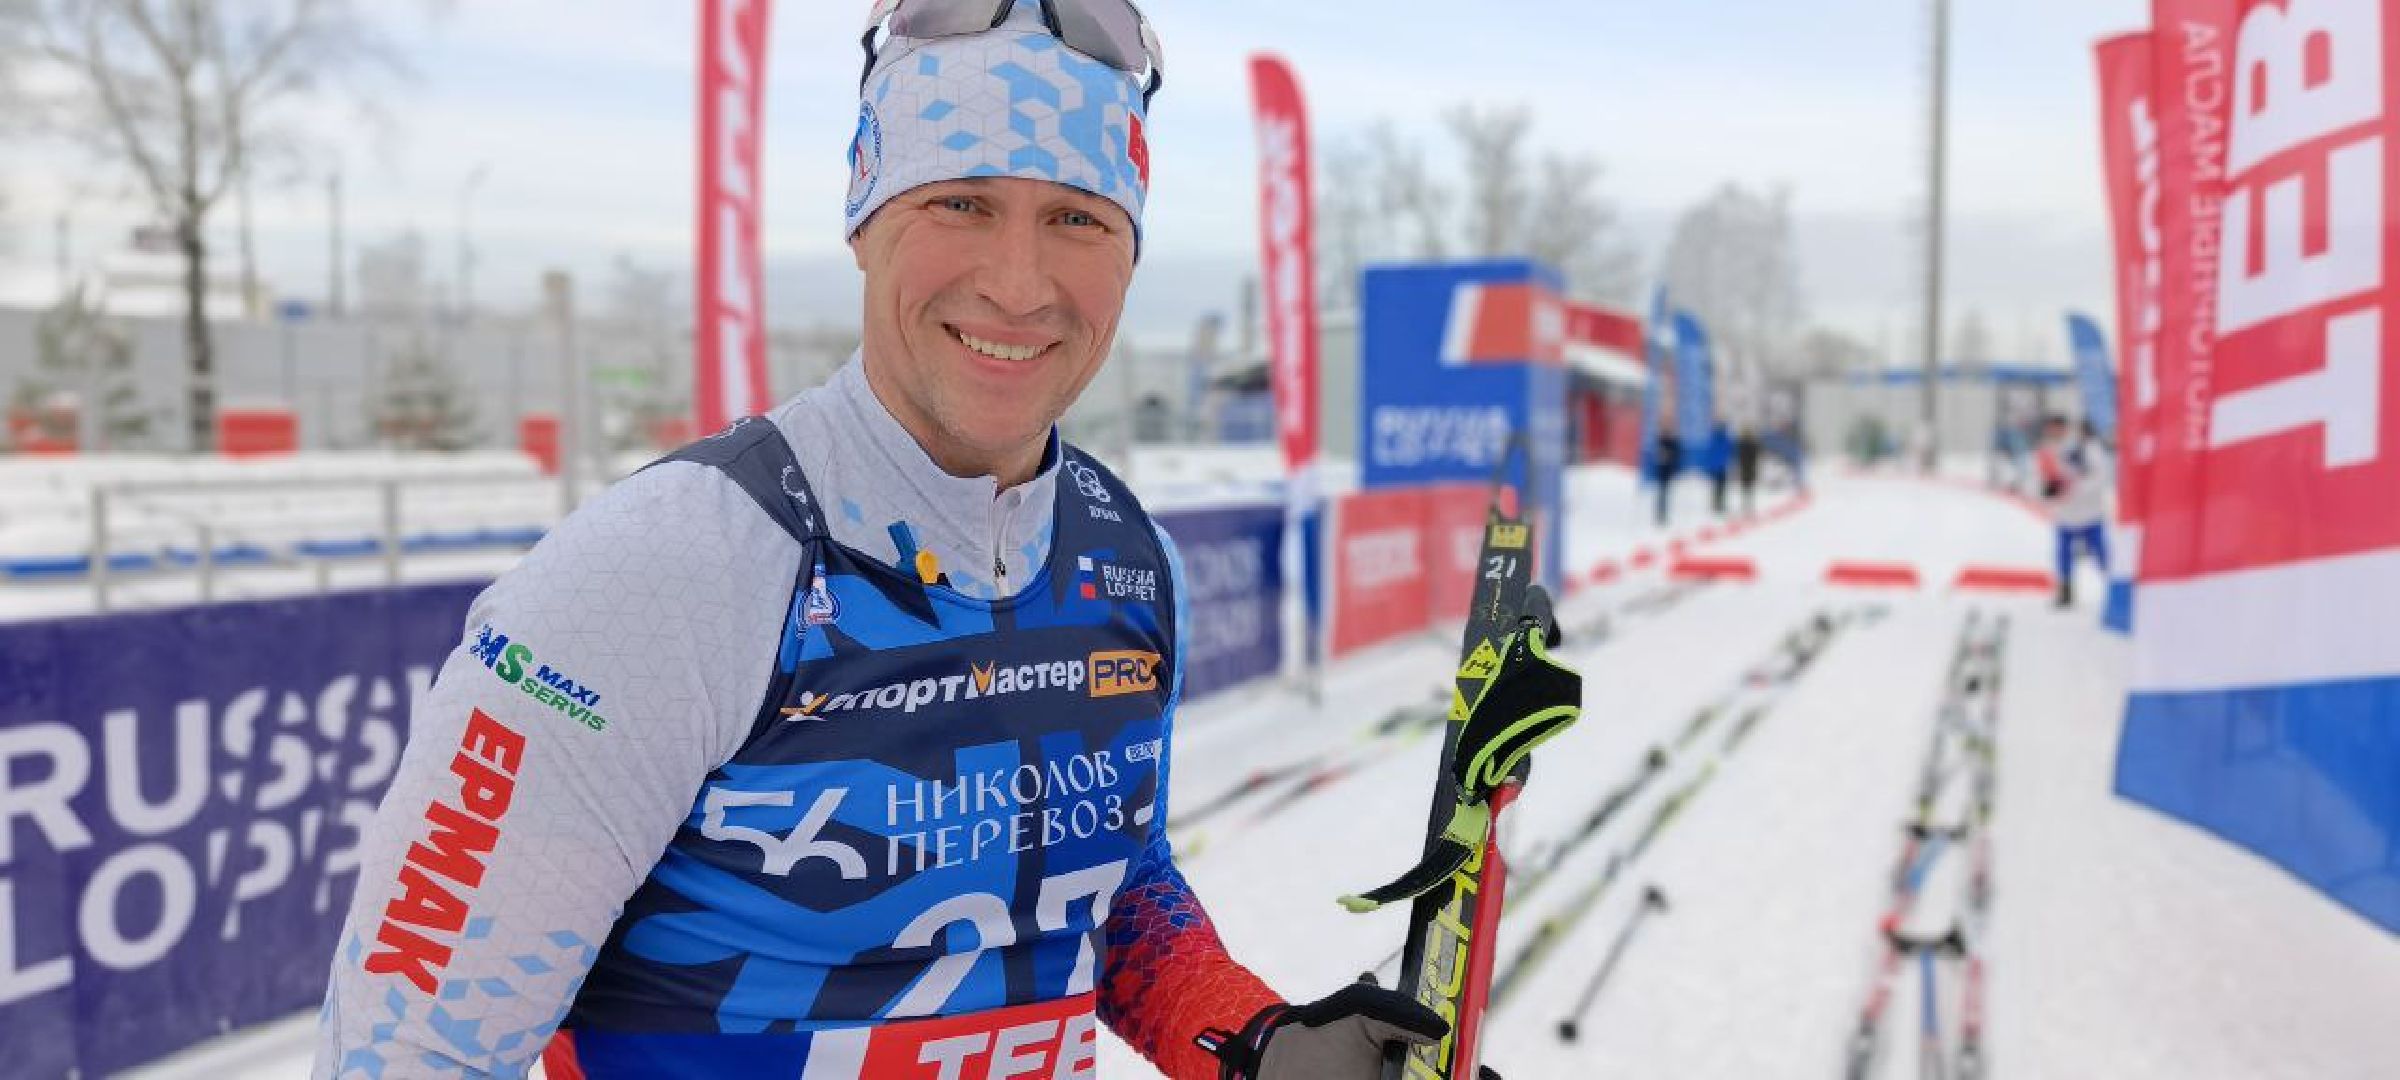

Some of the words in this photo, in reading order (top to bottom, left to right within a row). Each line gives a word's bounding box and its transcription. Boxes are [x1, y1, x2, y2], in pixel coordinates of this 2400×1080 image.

[1103, 566, 1156, 587] RUSSIA
[1485, 554, 1517, 580] 21
[520, 677, 606, 732] SERVIS
[536, 664, 601, 707] MAXI
[0, 665, 434, 864] RUSS
[887, 750, 1118, 826] НИКОЛОВ
[364, 706, 526, 997] ЕРМАК
[887, 795, 1124, 876] ПЕРЕВОЗ
[884, 858, 1128, 1019] 27
